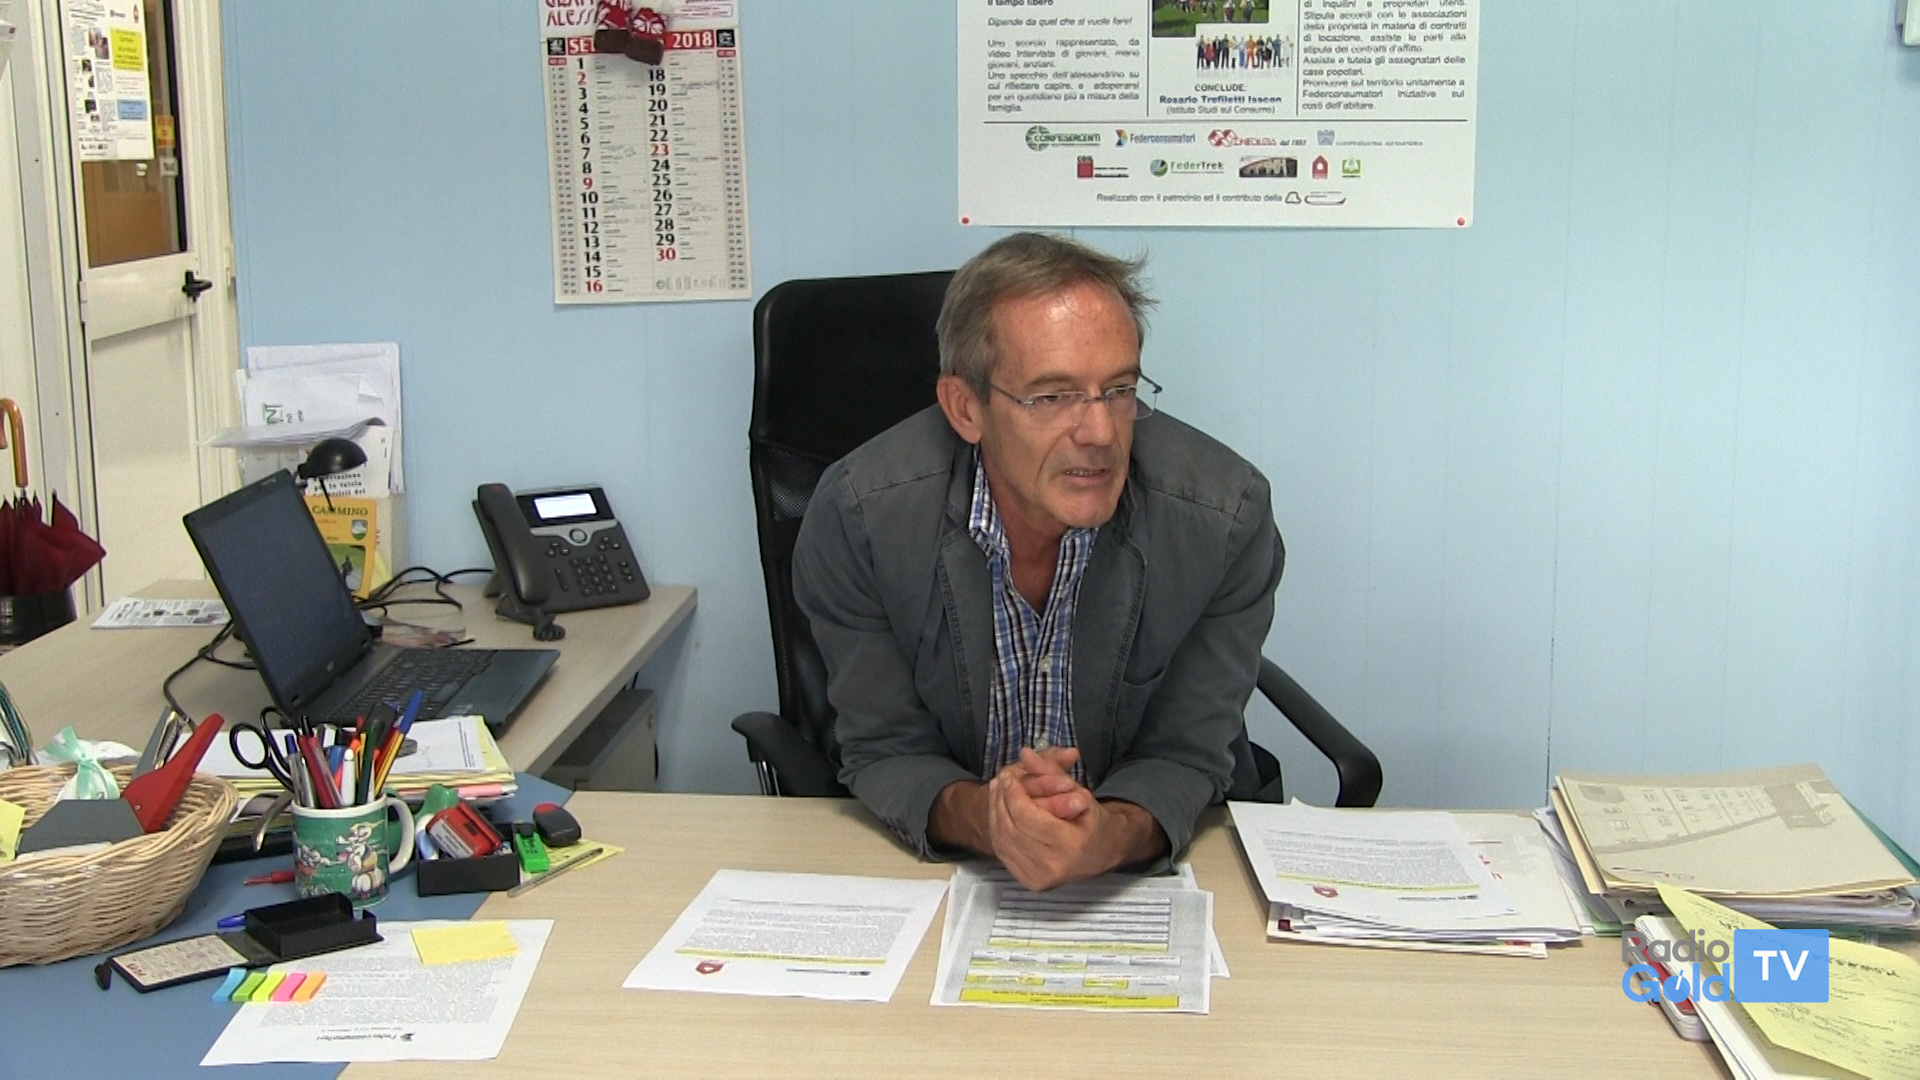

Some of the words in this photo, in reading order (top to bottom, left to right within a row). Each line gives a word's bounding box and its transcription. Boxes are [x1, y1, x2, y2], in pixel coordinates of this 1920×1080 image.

[988, 17, 1023, 27] Dipende
[1025, 18, 1037, 26] da
[1059, 18, 1075, 26] che
[1371, 22, 1379, 30] in
[1382, 22, 1416, 30] materia
[1419, 22, 1427, 30] di
[672, 31, 712, 48] 2018
[1129, 38, 1140, 46] da
[1303, 34, 1311, 42] di
[987, 50, 1011, 58] video
[1061, 50, 1069, 58] di
[1347, 56, 1372, 64] tutela
[577, 58, 584, 69] 1
[577, 71, 587, 85] 2
[648, 69, 665, 81] 18
[578, 87, 587, 99] 3
[648, 84, 666, 96] 19
[1194, 83, 1247, 92] CONCLUDE:
[1303, 89, 1383, 98] Federconsumatori
[648, 99, 668, 112] 20
[1160, 95, 1198, 104] Rosario
[579, 101, 589, 114] 4
[580, 117, 589, 129] 5
[649, 114, 665, 127] 21
[580, 132, 590, 144] 6
[650, 129, 668, 141] 22
[1130, 133, 1195, 144] Federconsumatori
[581, 147, 590, 159] 7
[650, 143, 669, 156] 23
[582, 162, 592, 174] 8
[652, 159, 670, 171] 24
[1170, 161, 1224, 170] FederTrek
[583, 177, 593, 189] 9
[652, 173, 671, 186] 25
[580, 191, 599, 204] 10
[653, 188, 672, 201] 26
[582, 207, 596, 219] 11
[654, 203, 672, 216] 27
[582, 222, 599, 234] 12
[654, 217, 674, 231] 28
[584, 236, 600, 248] 13
[655, 233, 675, 246] 29
[584, 251, 601, 263] 14
[656, 247, 676, 261] 30
[585, 266, 601, 278] 15
[585, 280, 603, 292] 16
